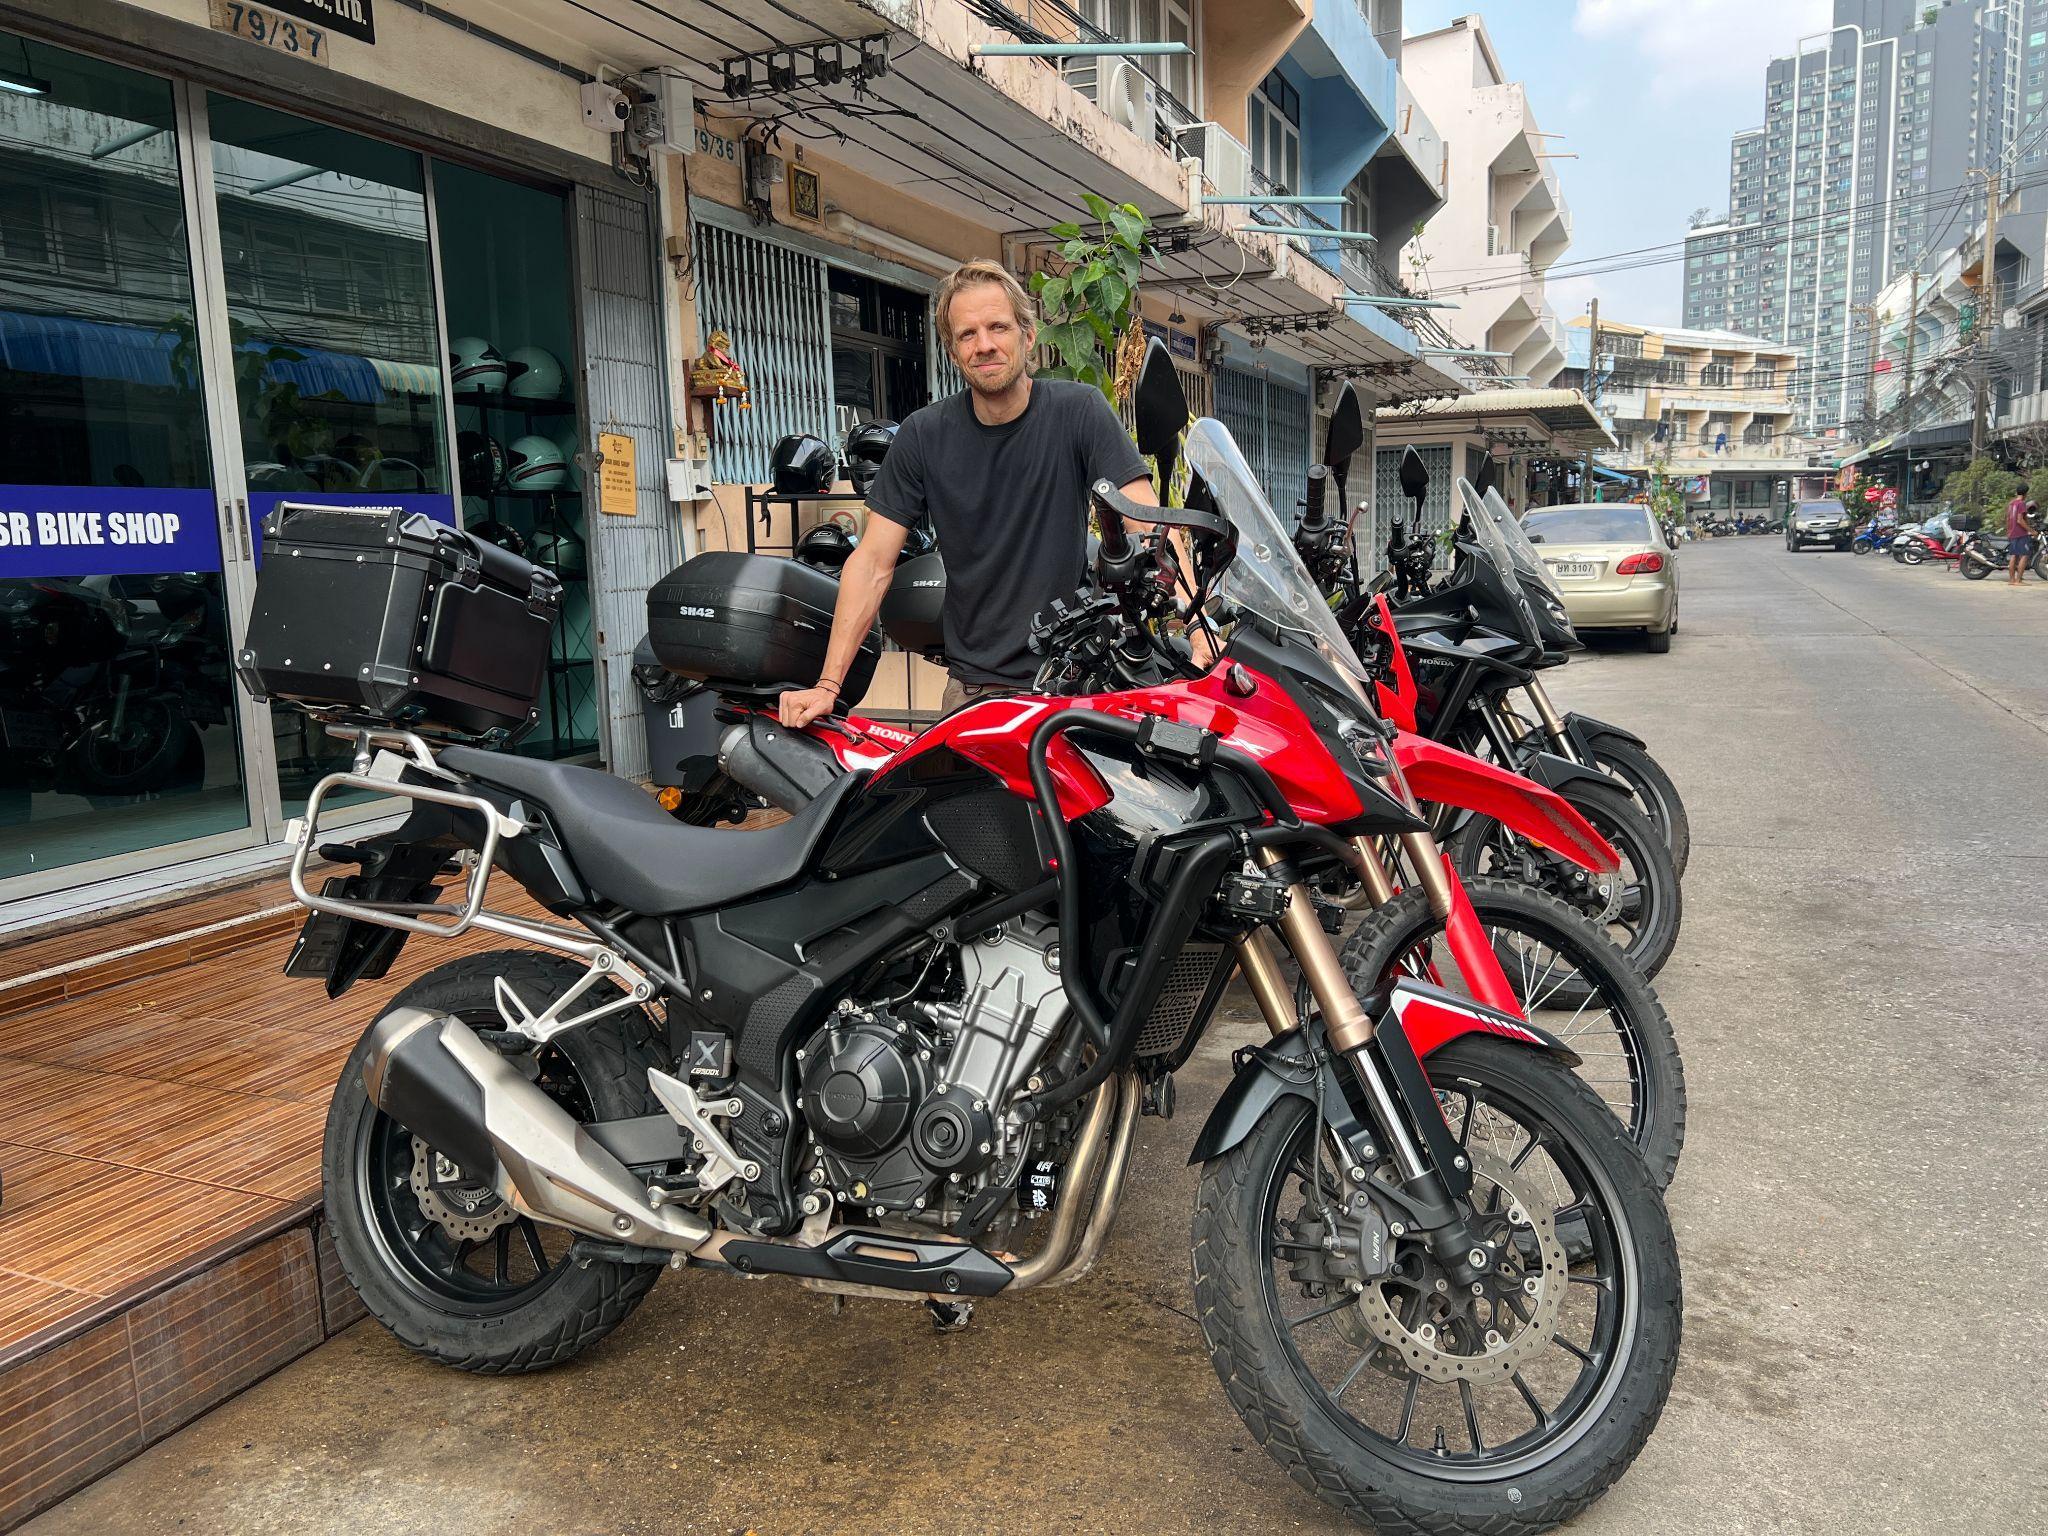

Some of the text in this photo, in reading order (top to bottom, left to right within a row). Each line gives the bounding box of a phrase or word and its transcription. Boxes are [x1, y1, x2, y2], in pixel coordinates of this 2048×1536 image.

[226, 2, 323, 58] 79/37
[694, 128, 735, 161] 9/36
[0, 511, 181, 547] SR BIKE SHOP
[1572, 564, 1593, 573] 3107
[912, 580, 941, 588] SH47
[680, 605, 715, 618] SH42
[1418, 657, 1455, 667] HONDA
[867, 724, 916, 744] HOND
[694, 1039, 720, 1067] X
